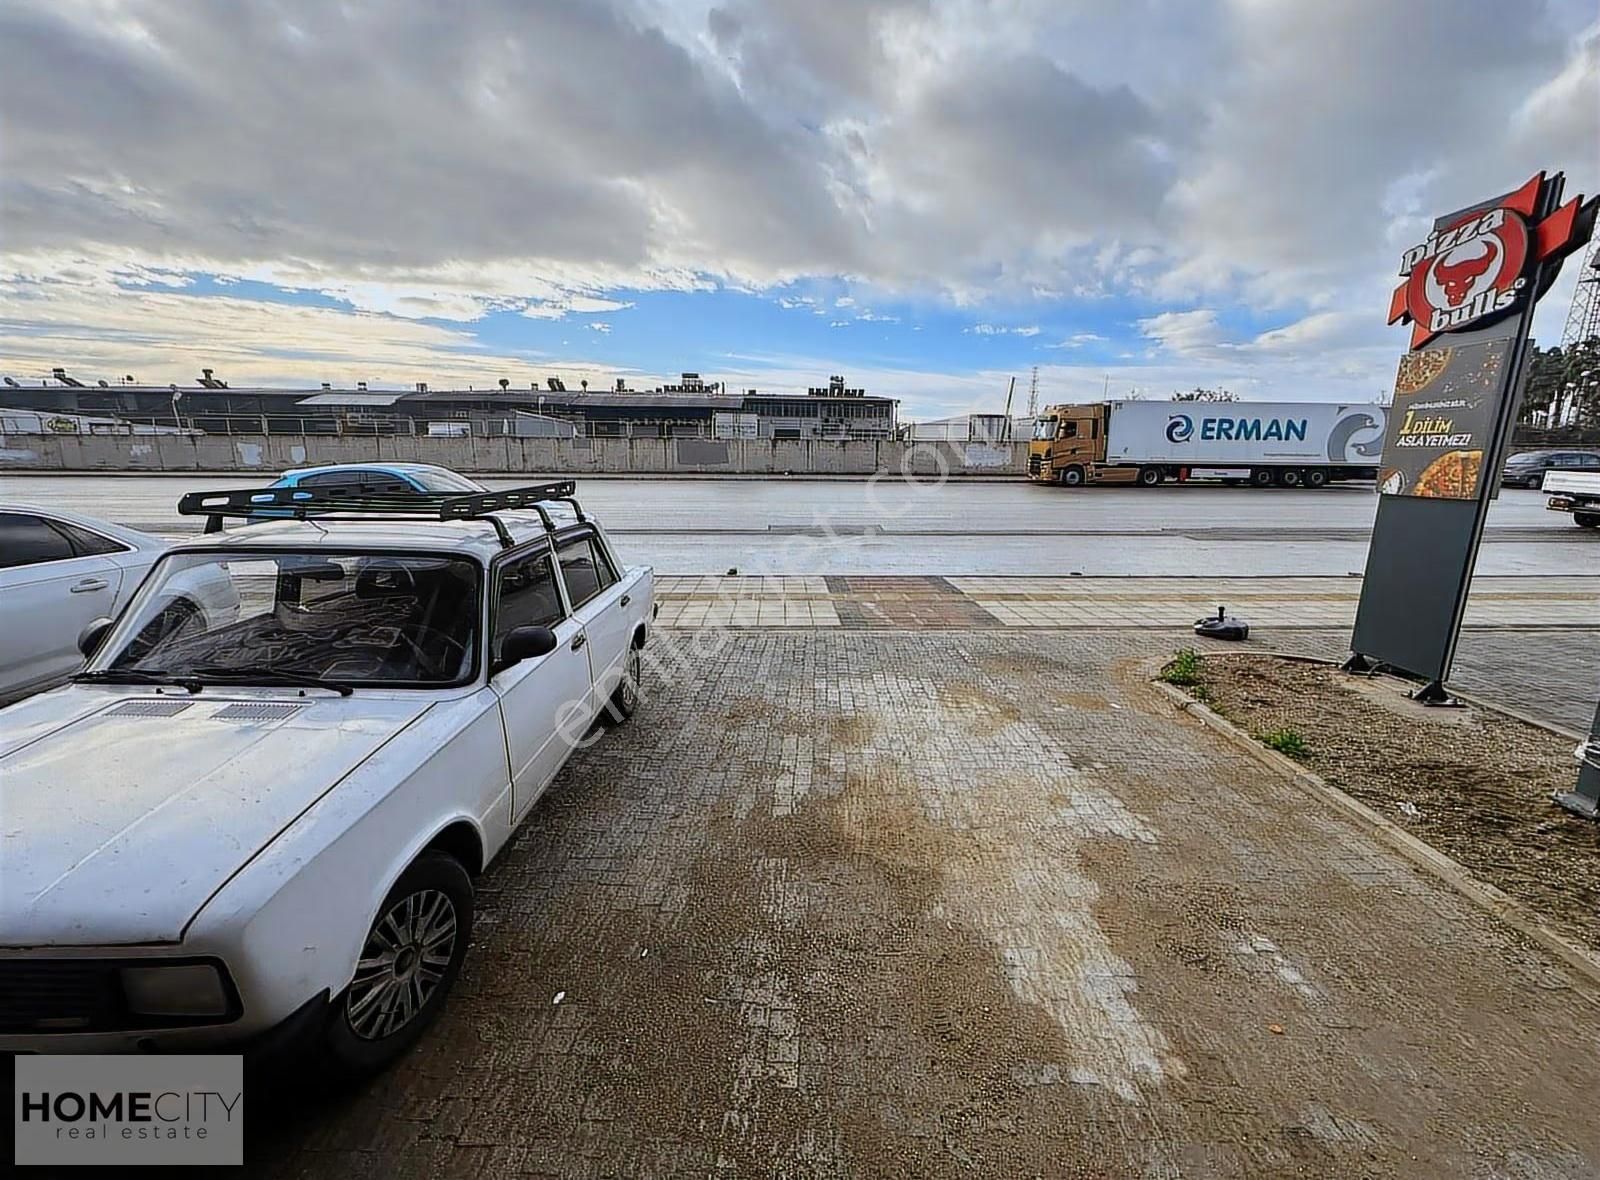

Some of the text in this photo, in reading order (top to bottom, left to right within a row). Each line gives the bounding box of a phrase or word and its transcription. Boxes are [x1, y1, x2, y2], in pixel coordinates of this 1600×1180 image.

[1399, 209, 1504, 276] pizza
[1430, 288, 1516, 332] bulls
[1202, 419, 1307, 441] ERMAN
[1399, 410, 1453, 435] 1 DİLİM
[1396, 433, 1472, 447] ASLA YETMEZ!
